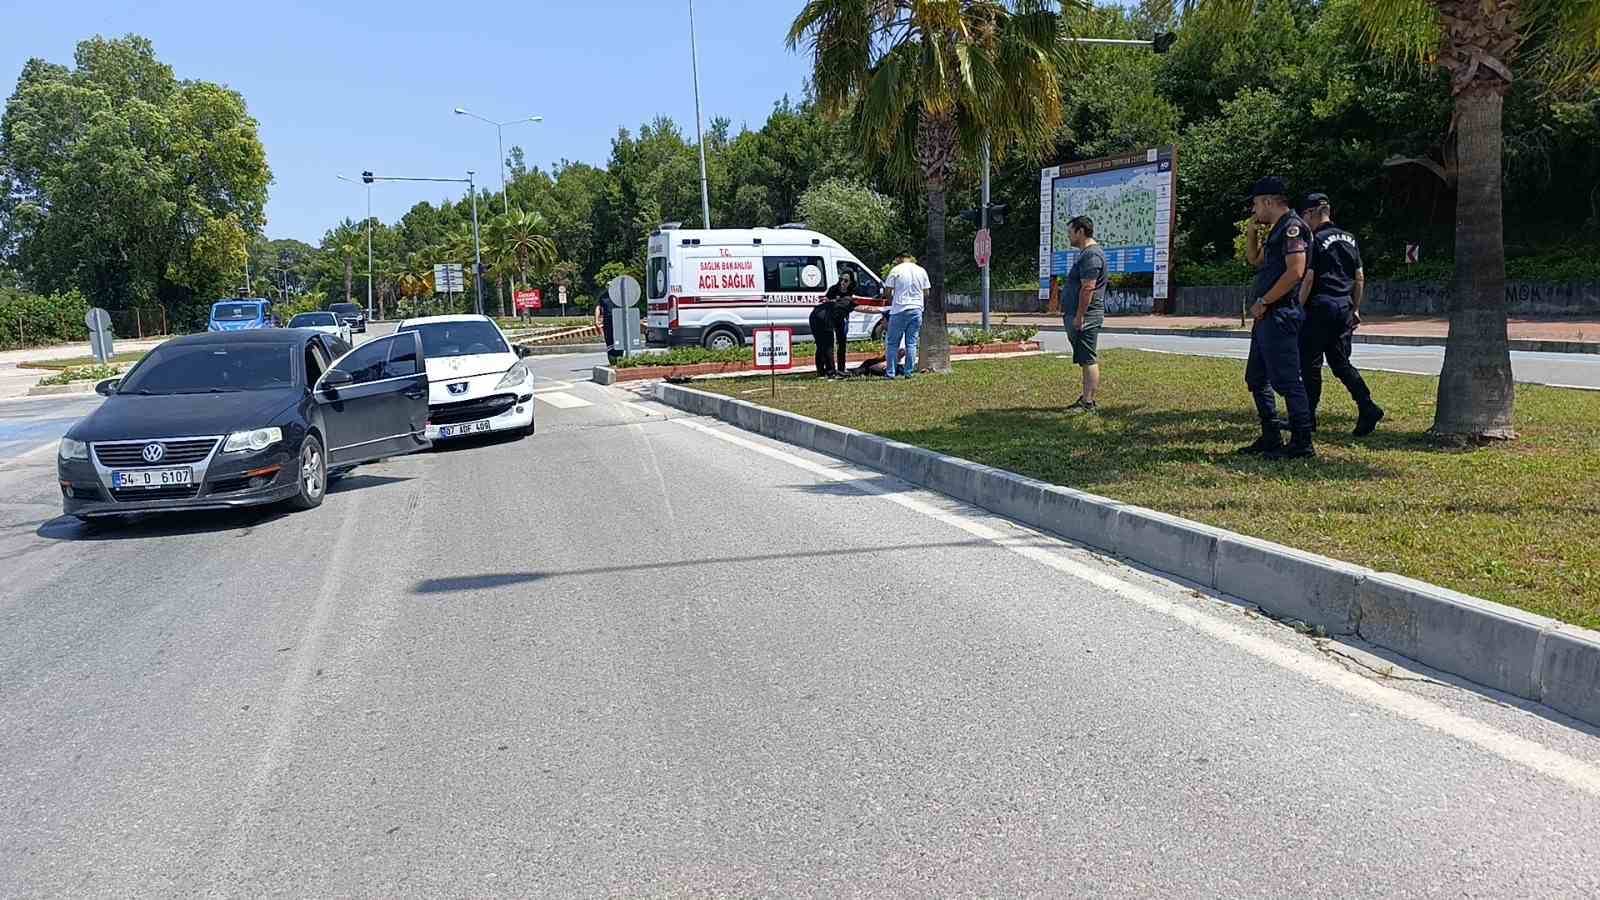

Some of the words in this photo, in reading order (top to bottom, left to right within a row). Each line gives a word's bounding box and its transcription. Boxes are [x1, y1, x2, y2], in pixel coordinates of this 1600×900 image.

[721, 272, 755, 289] SAĞLIK
[768, 294, 820, 304] AMBULANS
[120, 473, 134, 485] 54
[144, 472, 151, 484] D
[161, 470, 189, 483] 6107
